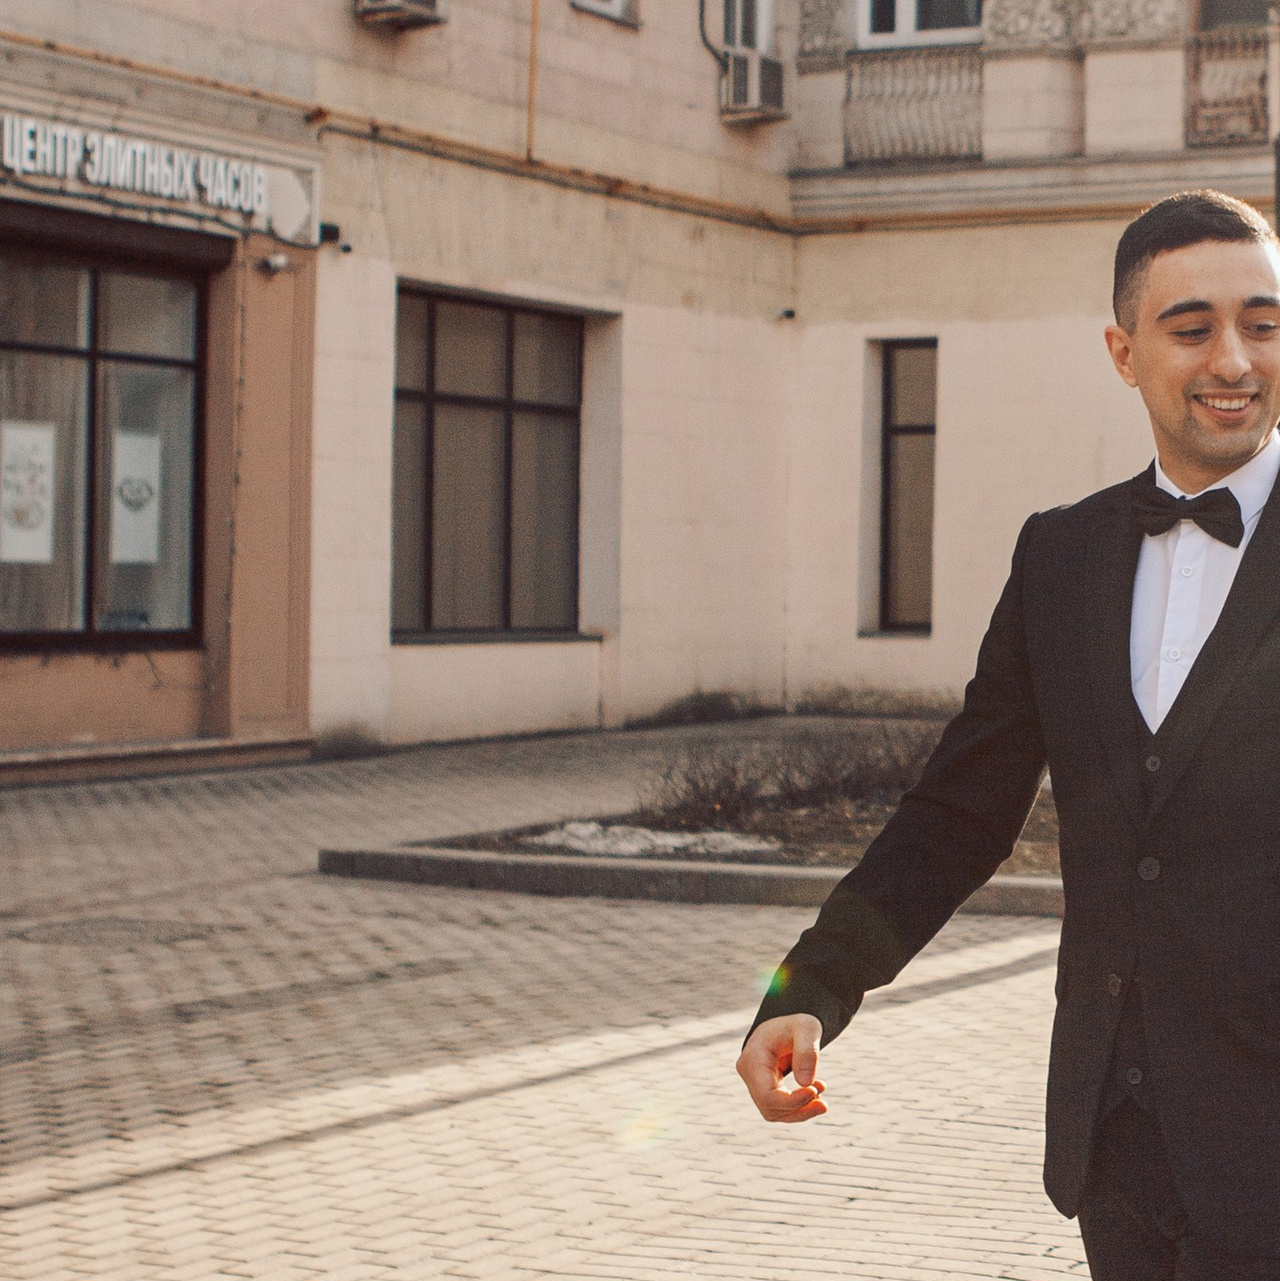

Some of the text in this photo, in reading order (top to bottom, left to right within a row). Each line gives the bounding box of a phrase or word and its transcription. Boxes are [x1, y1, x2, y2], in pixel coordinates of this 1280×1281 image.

[3, 116, 267, 214] ЦЕНТР ЭЛИТНЫХ ЧАСОВ
